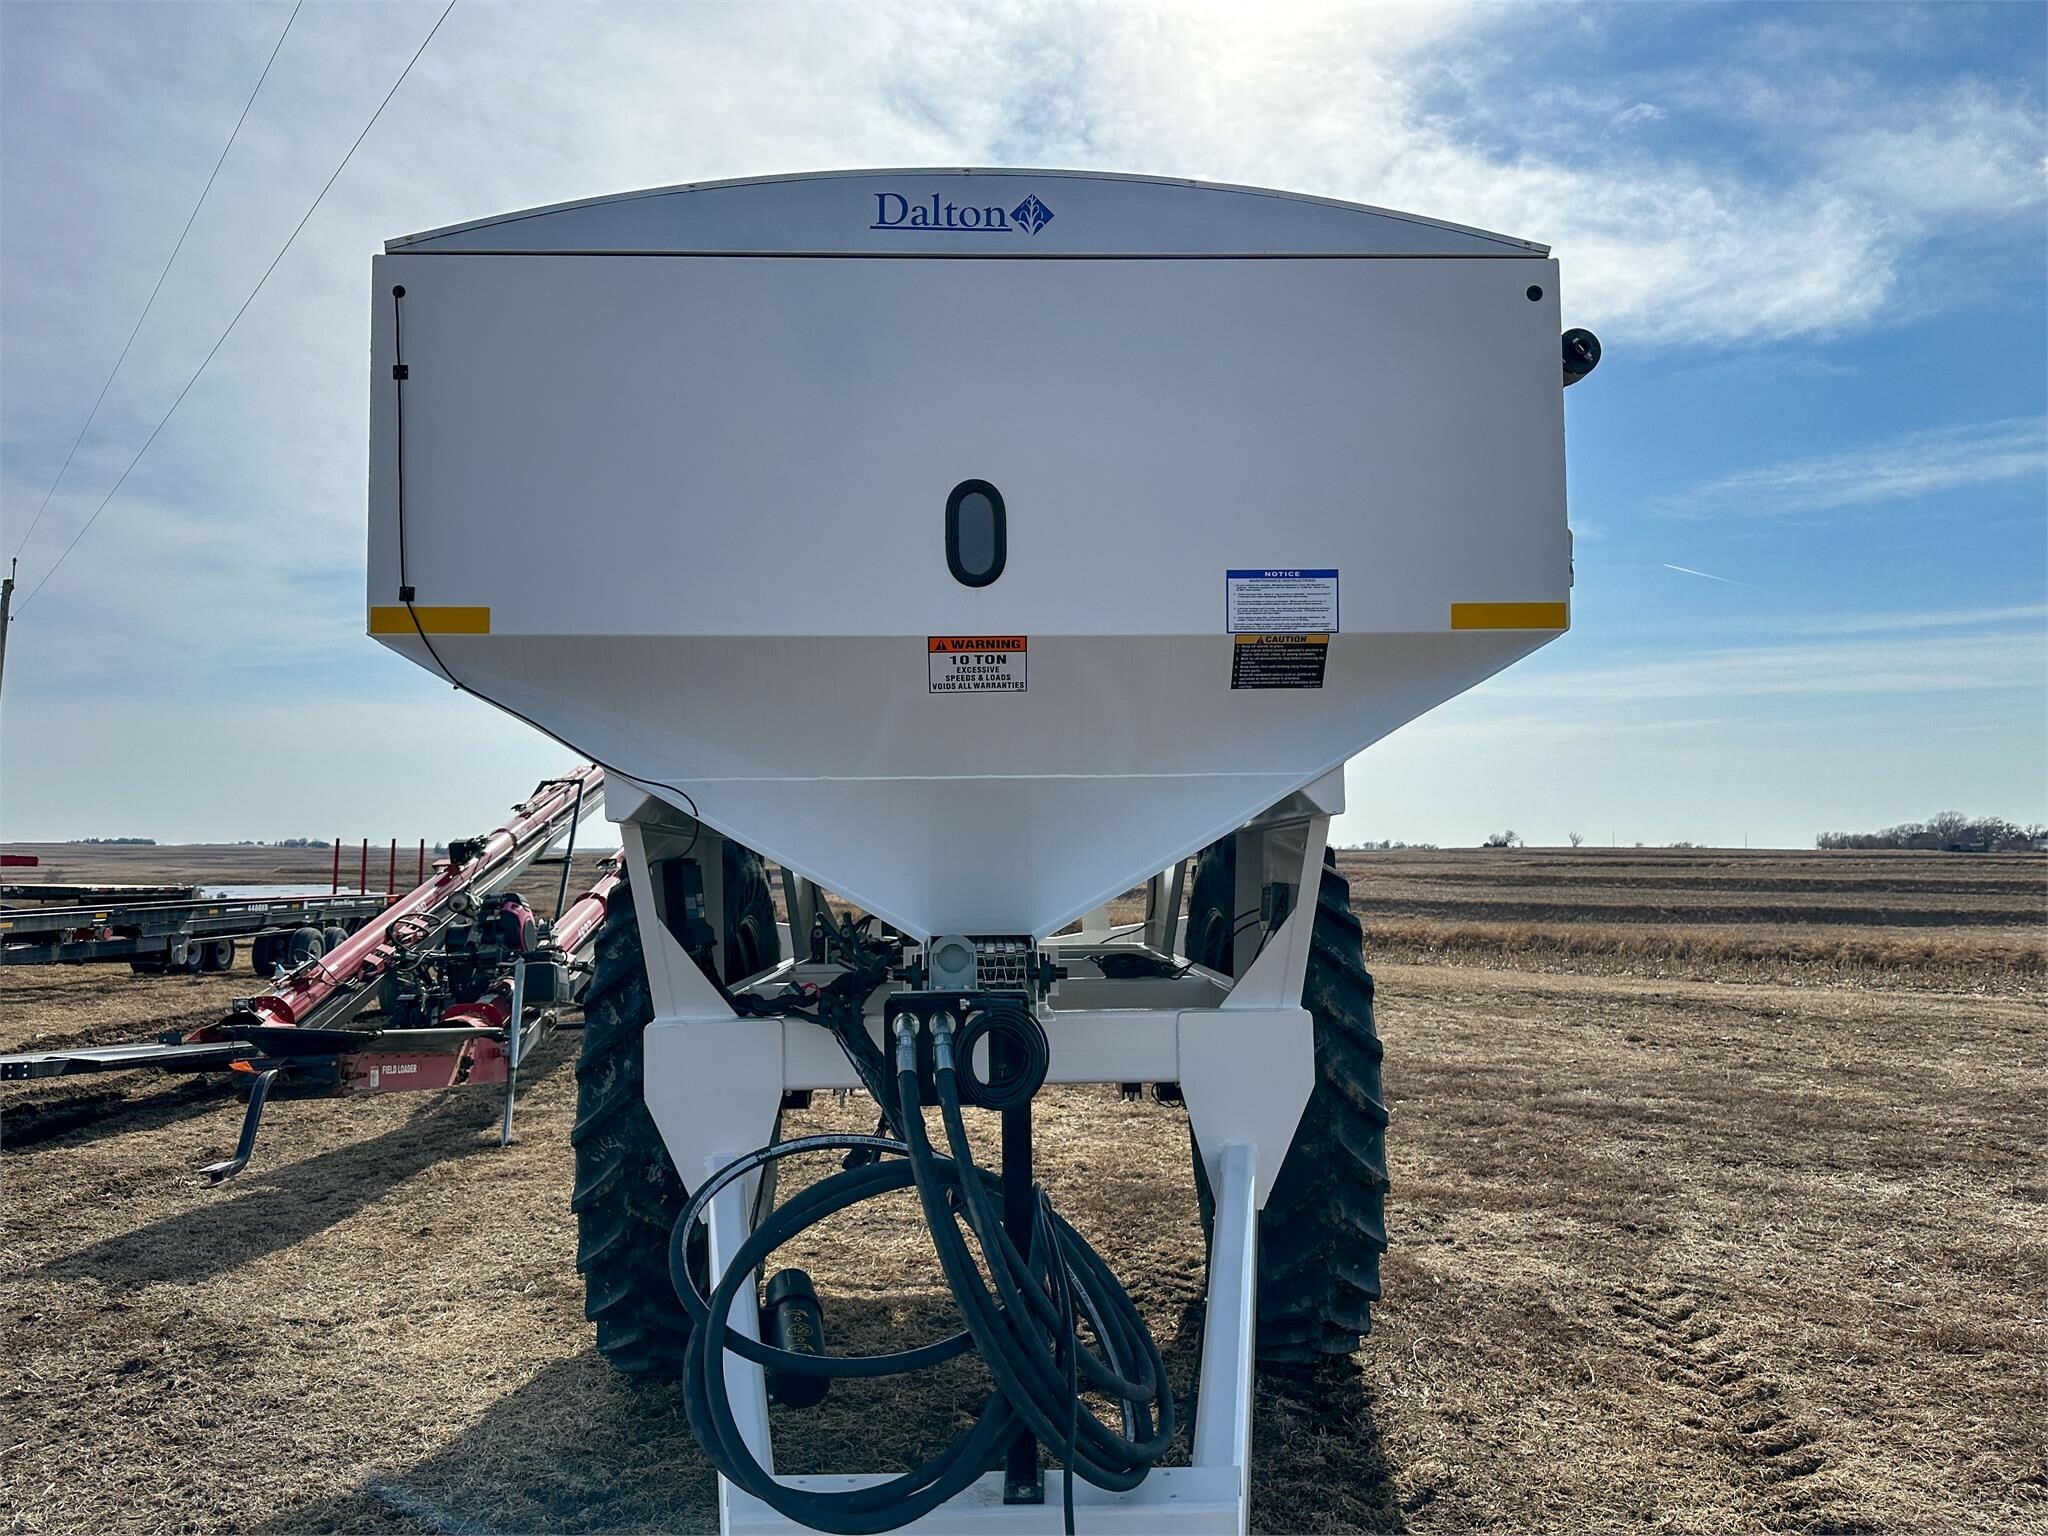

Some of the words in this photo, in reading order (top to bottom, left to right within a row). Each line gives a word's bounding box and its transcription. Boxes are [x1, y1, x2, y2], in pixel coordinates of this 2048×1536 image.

[874, 193, 1008, 228] Dalton
[1265, 635, 1307, 643] CAUTION
[951, 640, 1020, 649] WARNING
[949, 655, 970, 665] 10
[974, 654, 1007, 665] TON
[945, 674, 976, 682] SPEEDS
[932, 682, 956, 690] VOIDS
[973, 681, 1025, 689] WARRANTIES
[382, 1065, 397, 1074] FIELD
[397, 1064, 417, 1073] LOADER
